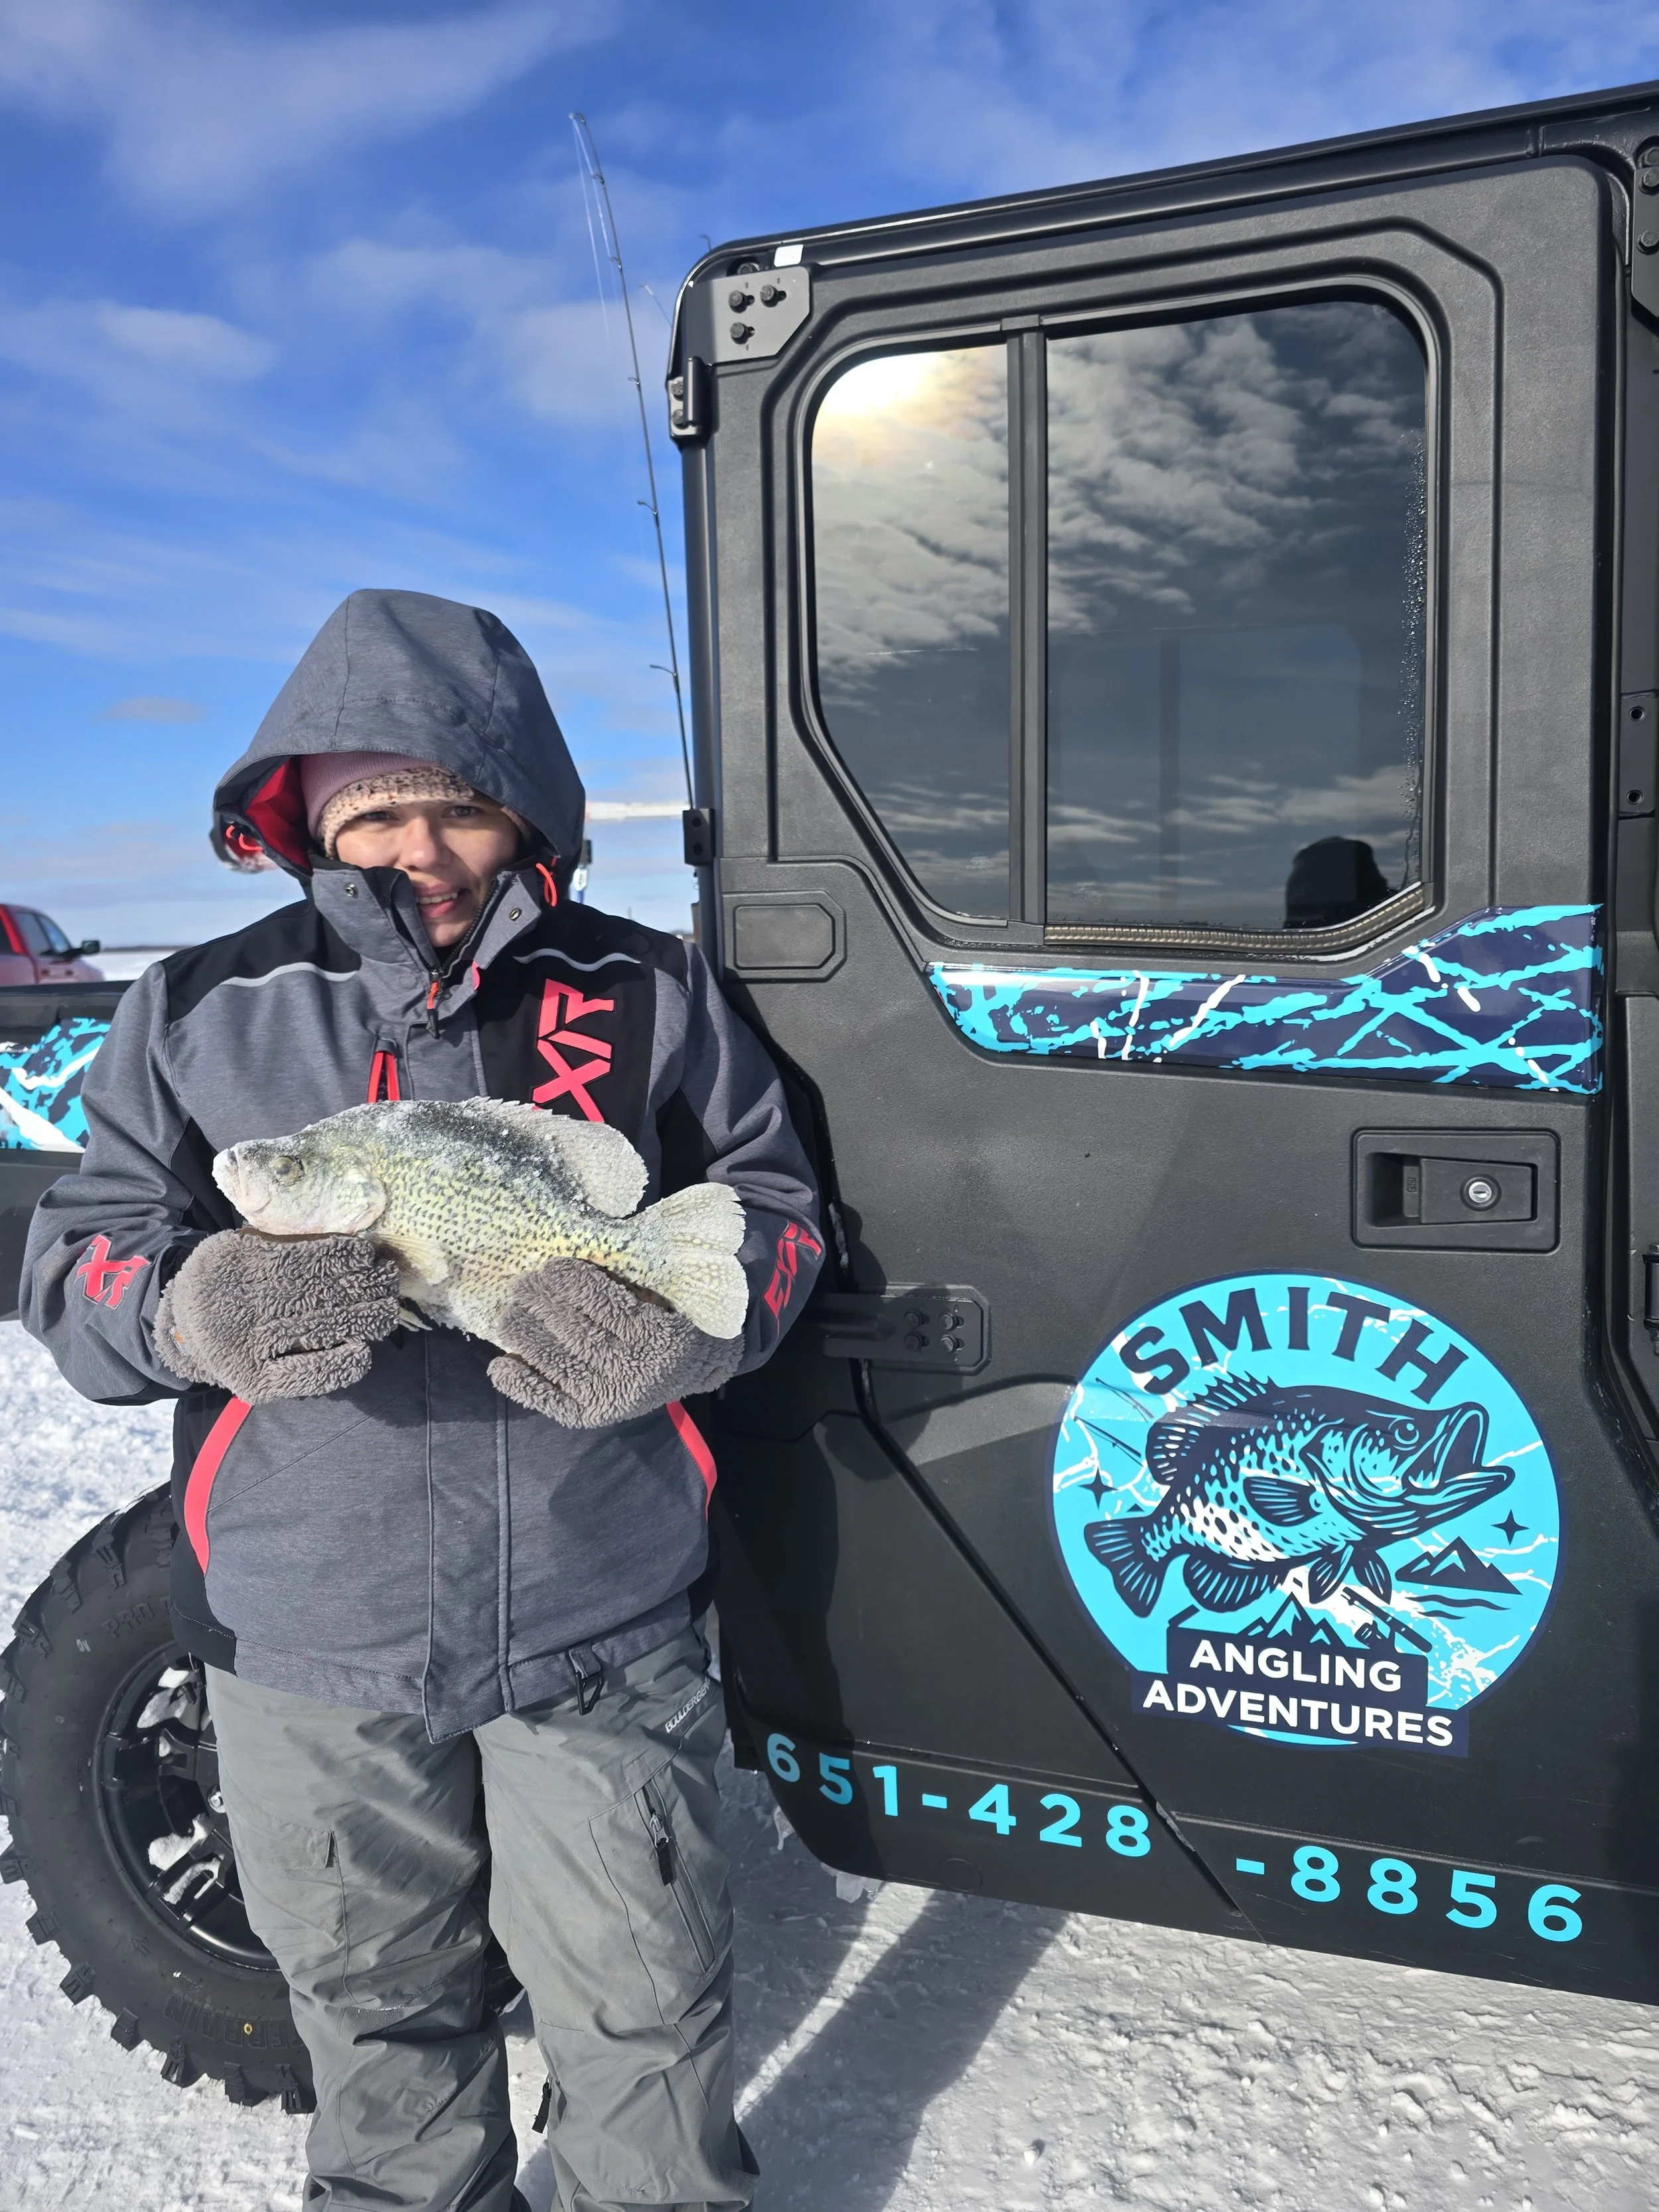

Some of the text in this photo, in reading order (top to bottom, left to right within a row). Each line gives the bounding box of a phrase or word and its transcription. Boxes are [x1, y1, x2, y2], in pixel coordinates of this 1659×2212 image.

[532, 978, 614, 1123] XR
[1119, 1286, 1469, 1404] SMITH
[1190, 1639, 1402, 1692] ANGLING
[1143, 1679, 1454, 1747] ADVENTURES
